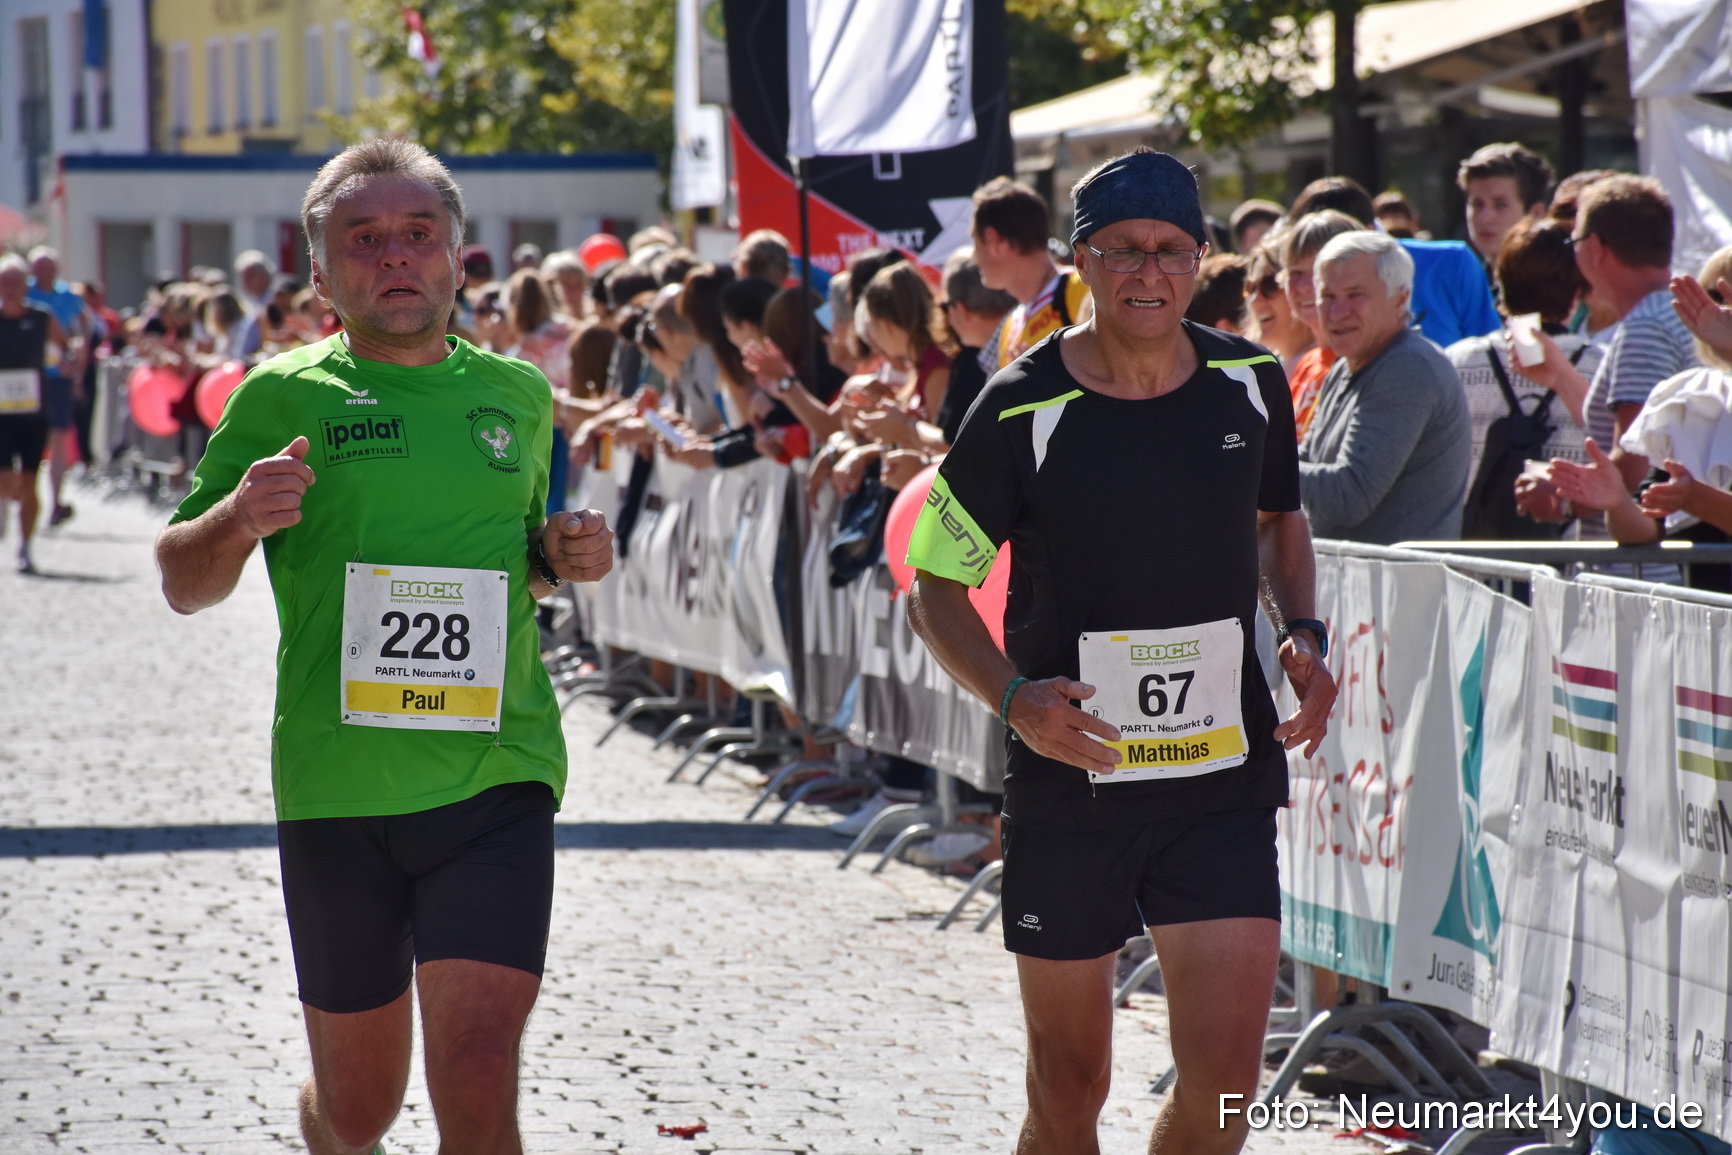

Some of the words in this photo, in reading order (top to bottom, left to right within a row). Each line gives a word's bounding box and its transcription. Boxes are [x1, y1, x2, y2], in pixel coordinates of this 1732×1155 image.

[345, 397, 378, 406] erima
[465, 408, 479, 422] SC
[478, 405, 517, 426] Kemmern
[324, 417, 402, 450] ipalat
[328, 446, 404, 462] HALSPASTILLEN
[487, 460, 522, 474] RUNNING
[390, 580, 464, 600] BOCK
[390, 597, 414, 605] inspired
[414, 598, 422, 606] by
[379, 610, 471, 662] 228
[351, 646, 357, 656] D
[1130, 640, 1200, 660] BOCK
[1130, 660, 1154, 668] inspired
[1154, 660, 1162, 668] by
[1162, 659, 1179, 667] smart
[1179, 656, 1202, 665] concepts
[375, 666, 411, 678] PARTL
[412, 667, 462, 680] Neumarkt
[401, 688, 446, 711] Paul
[1137, 669, 1196, 718] 67
[1120, 724, 1156, 734] PARTL
[1157, 719, 1201, 733] Neumarkt
[1127, 741, 1210, 765] Matthias
